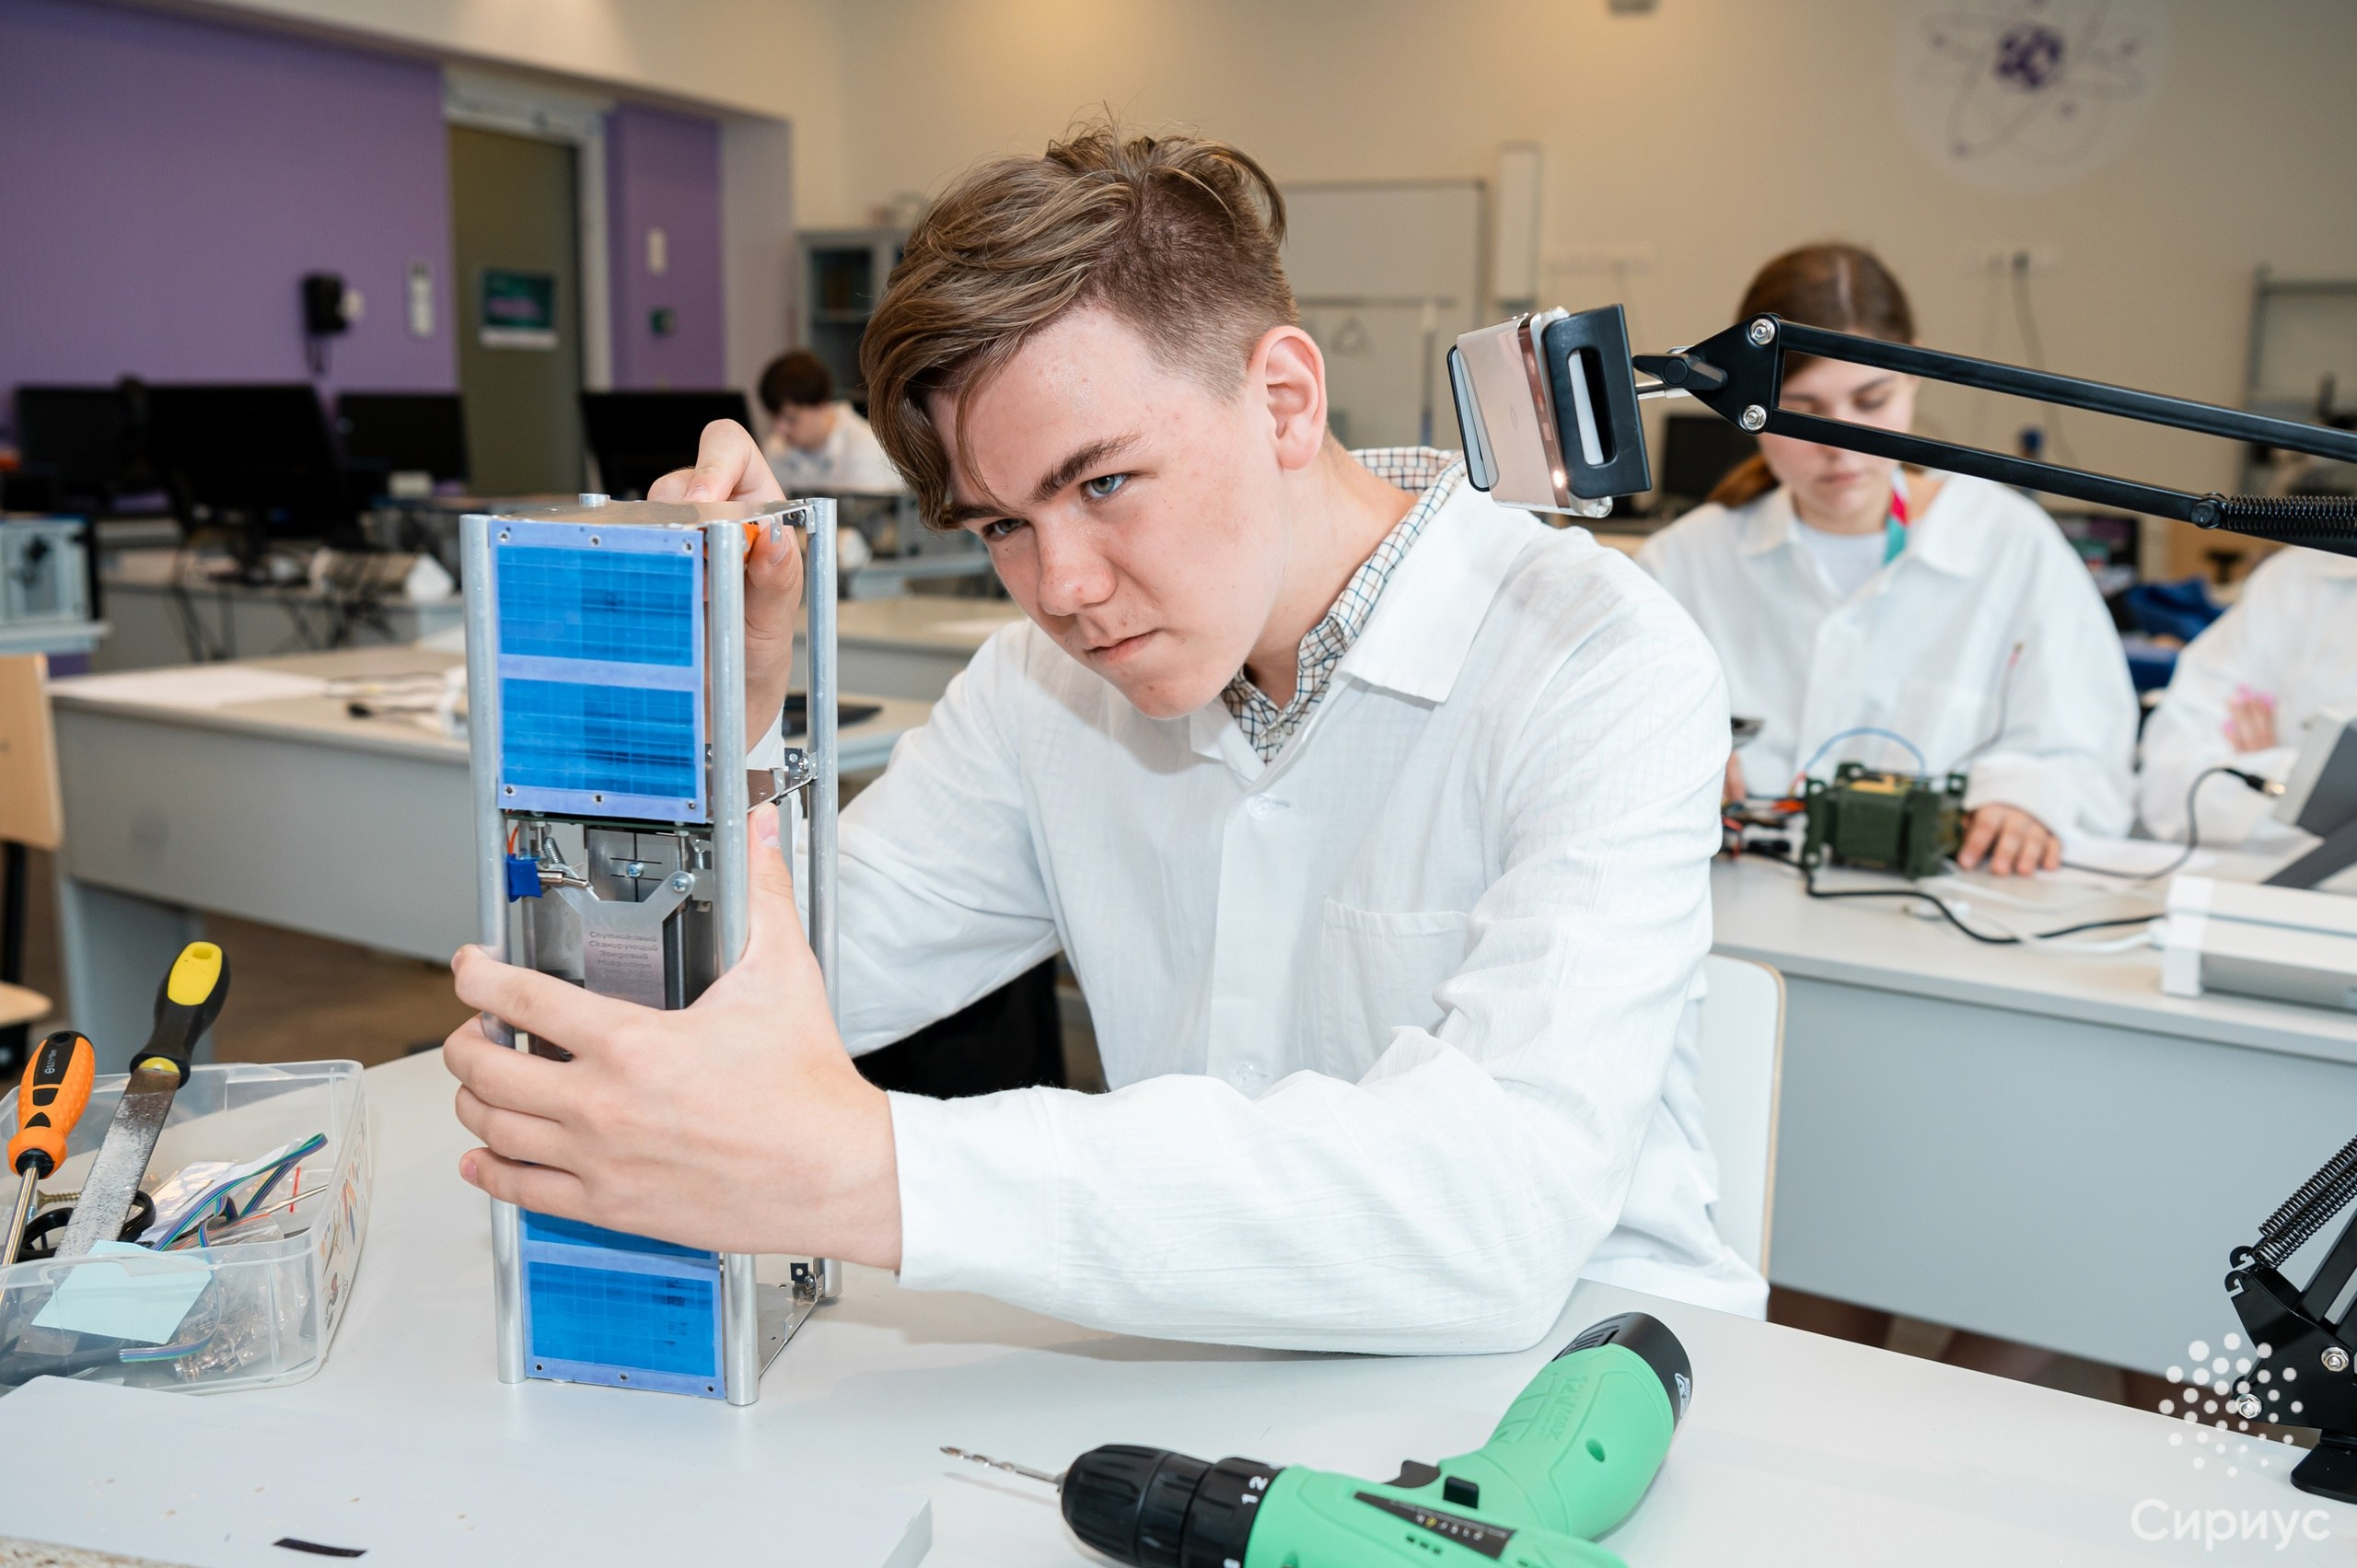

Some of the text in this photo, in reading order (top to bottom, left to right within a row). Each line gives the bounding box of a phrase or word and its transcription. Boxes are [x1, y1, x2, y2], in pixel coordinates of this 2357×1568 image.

[588, 940, 658, 951] Сканирующий
[598, 949, 649, 959] Зондовый
[1241, 1475, 1269, 1504] 1 2
